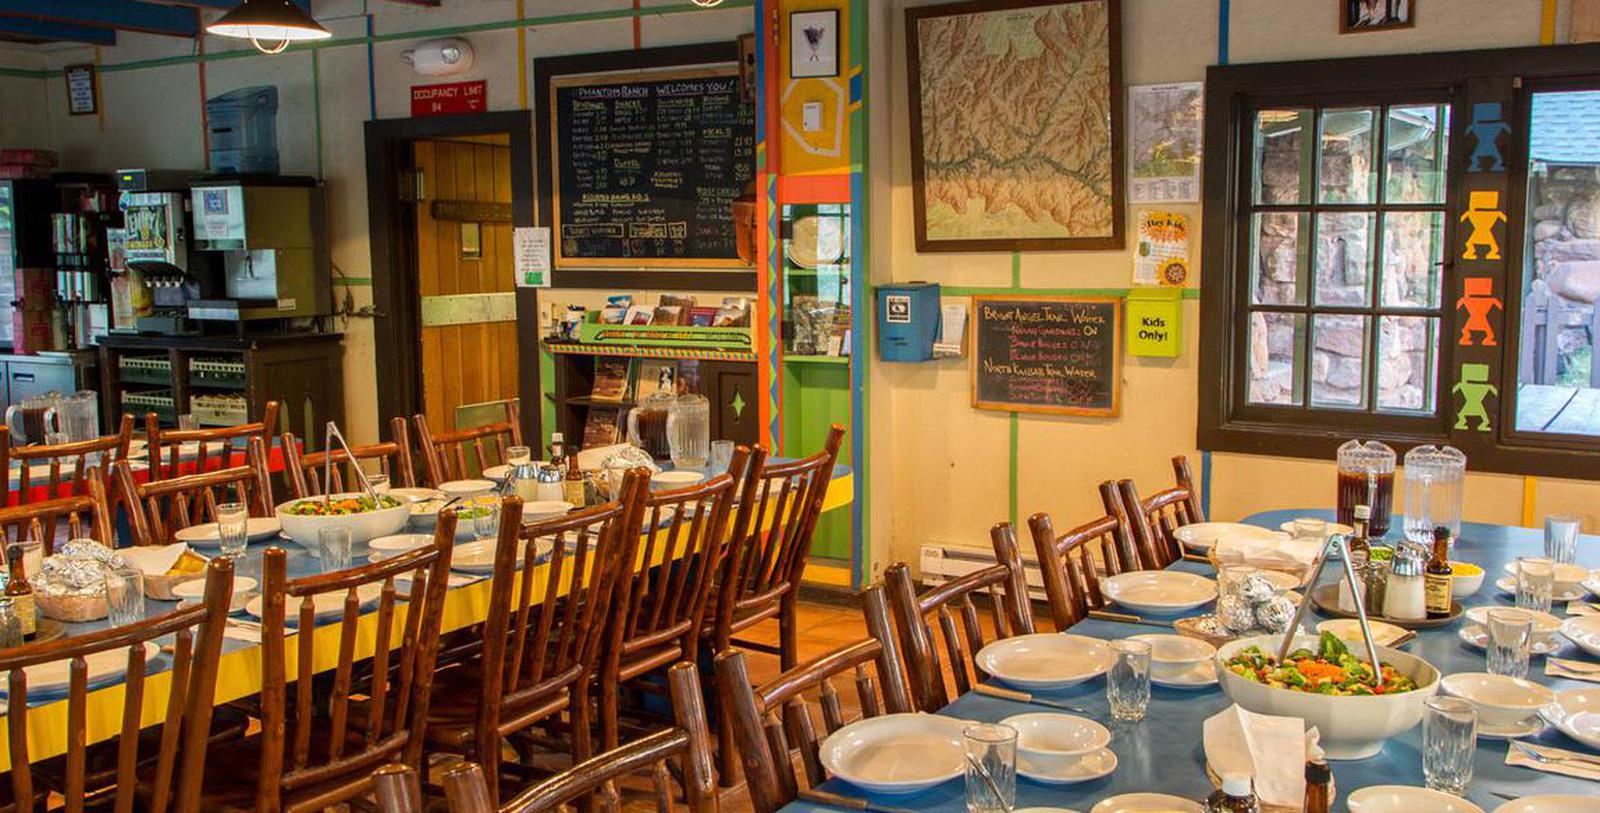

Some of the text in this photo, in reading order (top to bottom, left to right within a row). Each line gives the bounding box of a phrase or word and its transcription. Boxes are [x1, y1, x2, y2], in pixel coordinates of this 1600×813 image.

[413, 85, 483, 100] OCCUPANCY LIMIT
[620, 84, 648, 97] RANCH
[655, 83, 704, 96] WELCOMES
[705, 79, 734, 92] YOU!
[1142, 317, 1166, 327] Kids
[1139, 330, 1168, 342] Only!
